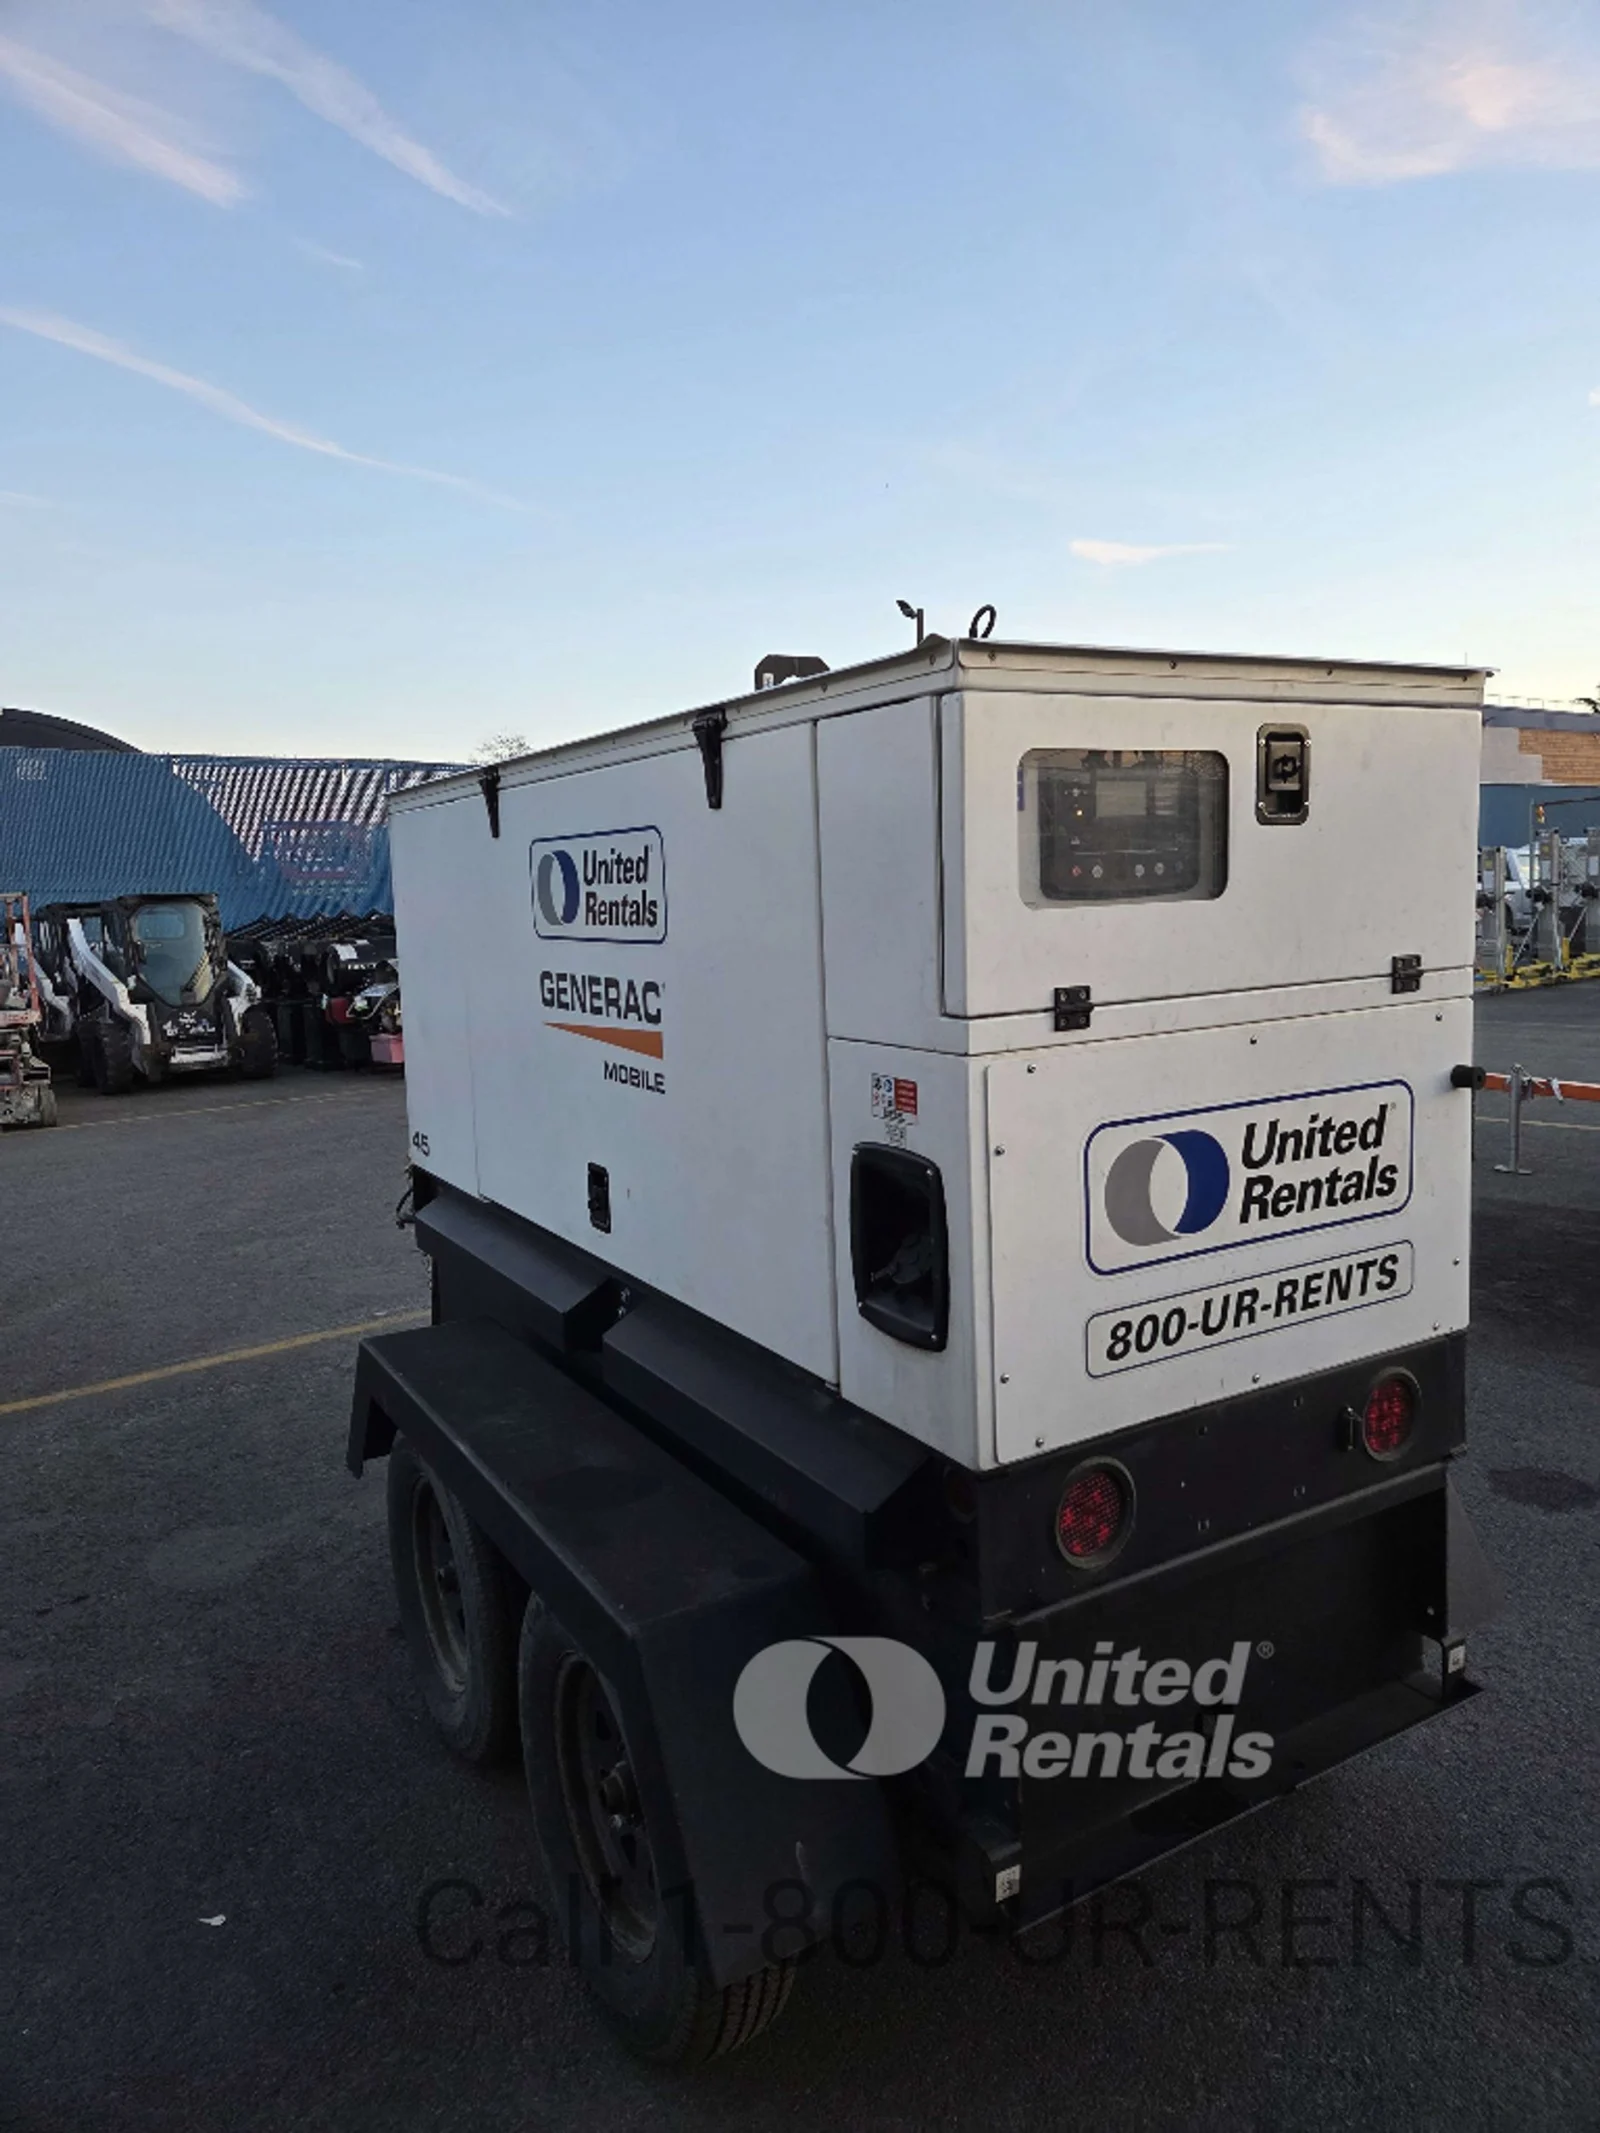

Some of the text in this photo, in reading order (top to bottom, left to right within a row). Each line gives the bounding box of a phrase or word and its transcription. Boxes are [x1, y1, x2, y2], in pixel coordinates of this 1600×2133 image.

[583, 845, 650, 886] United
[585, 890, 658, 928] Rentals
[539, 970, 661, 1024] GENERAC
[603, 1060, 666, 1095] MOBILE
[1241, 1104, 1388, 1170] United
[1239, 1155, 1399, 1225] Rentals
[1105, 1253, 1399, 1362] 800-UR-RENTS
